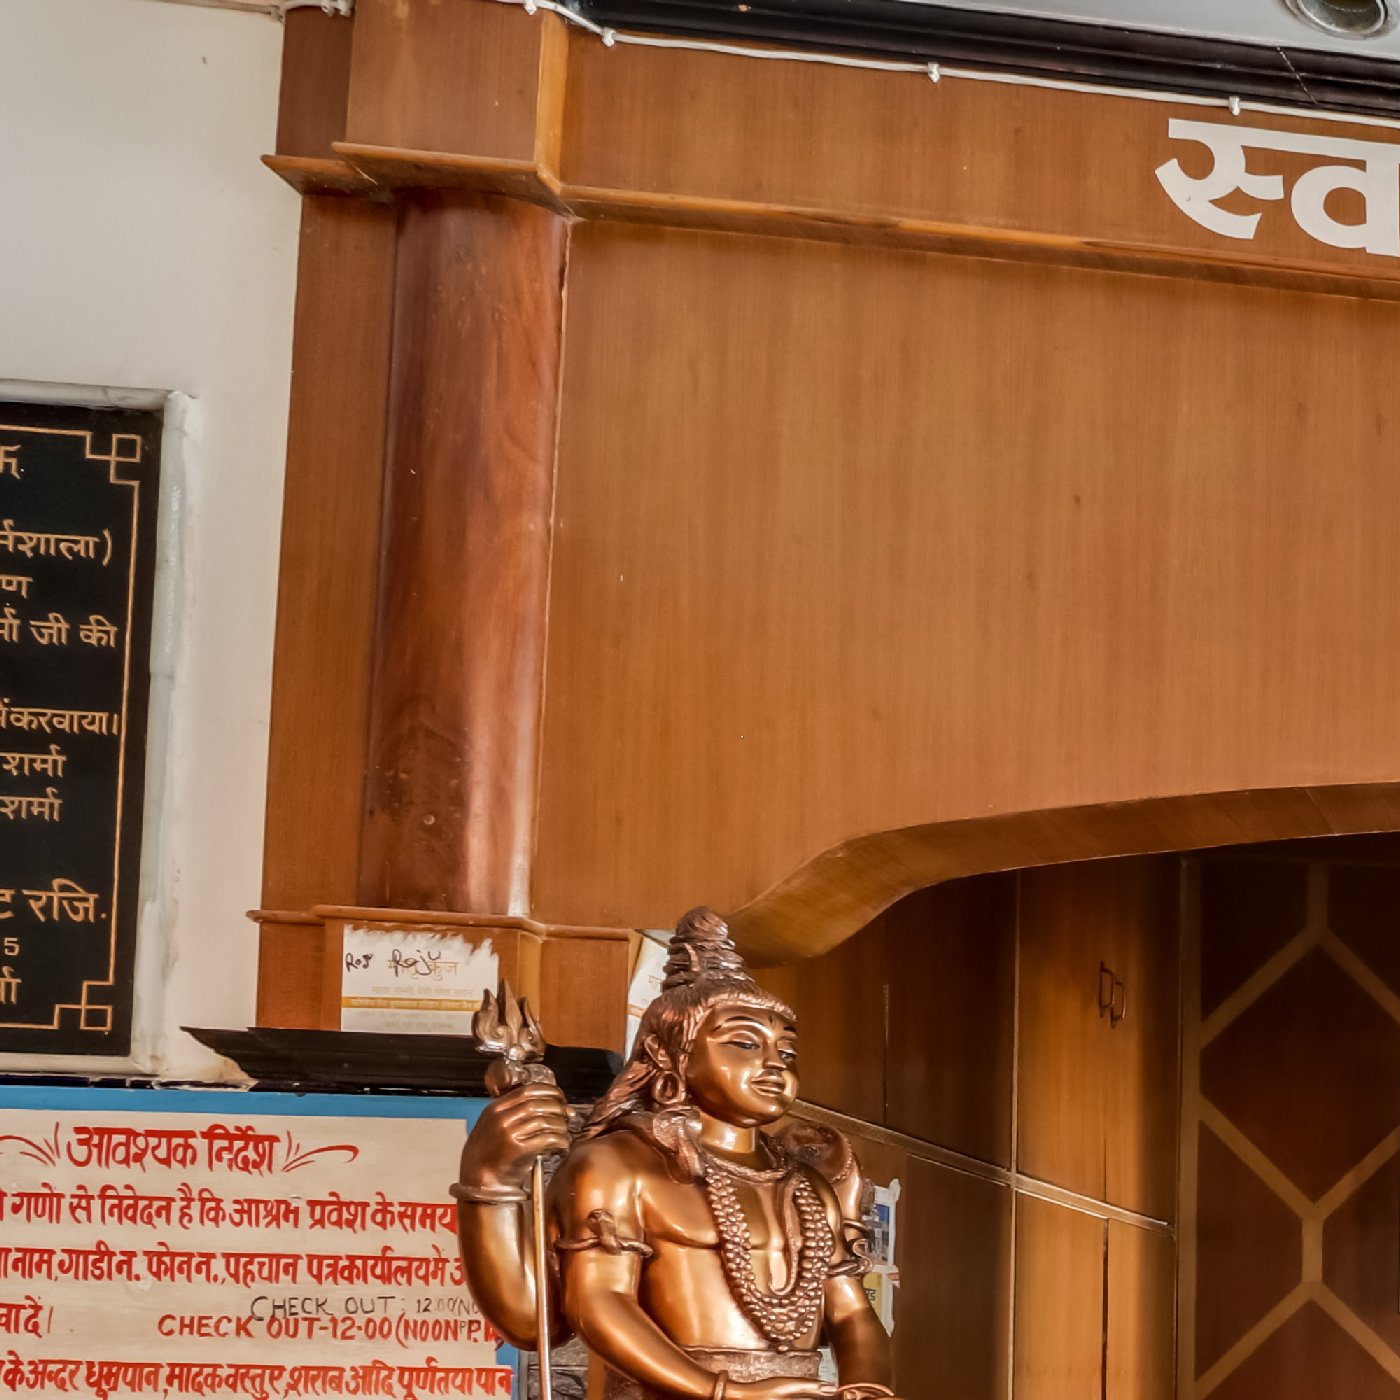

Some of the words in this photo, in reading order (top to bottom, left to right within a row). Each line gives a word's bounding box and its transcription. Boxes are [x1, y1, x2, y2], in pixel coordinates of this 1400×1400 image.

[29, 612, 70, 646] जी
[80, 615, 118, 648] की
[66, 1126, 198, 1173] आवश्यक
[68, 1184, 95, 1224] से
[98, 1184, 177, 1229] निवेदन
[177, 1182, 195, 1230] है
[196, 1187, 227, 1228] कि
[229, 1198, 300, 1230] आश्रम
[306, 1191, 370, 1234] प्रवेश
[370, 1191, 396, 1232] के
[221, 1252, 304, 1289] पहचान
[306, 1253, 344, 1286] पत्र
[339, 1245, 431, 1287] कार्यालय
[158, 1313, 255, 1338] CHECK
[250, 1296, 334, 1321] CHECK
[25, 1359, 84, 1392] अन्दर
[165, 1363, 225, 1396] मादक
[289, 1365, 345, 1397] शराब
[345, 1359, 398, 1399] आदि
